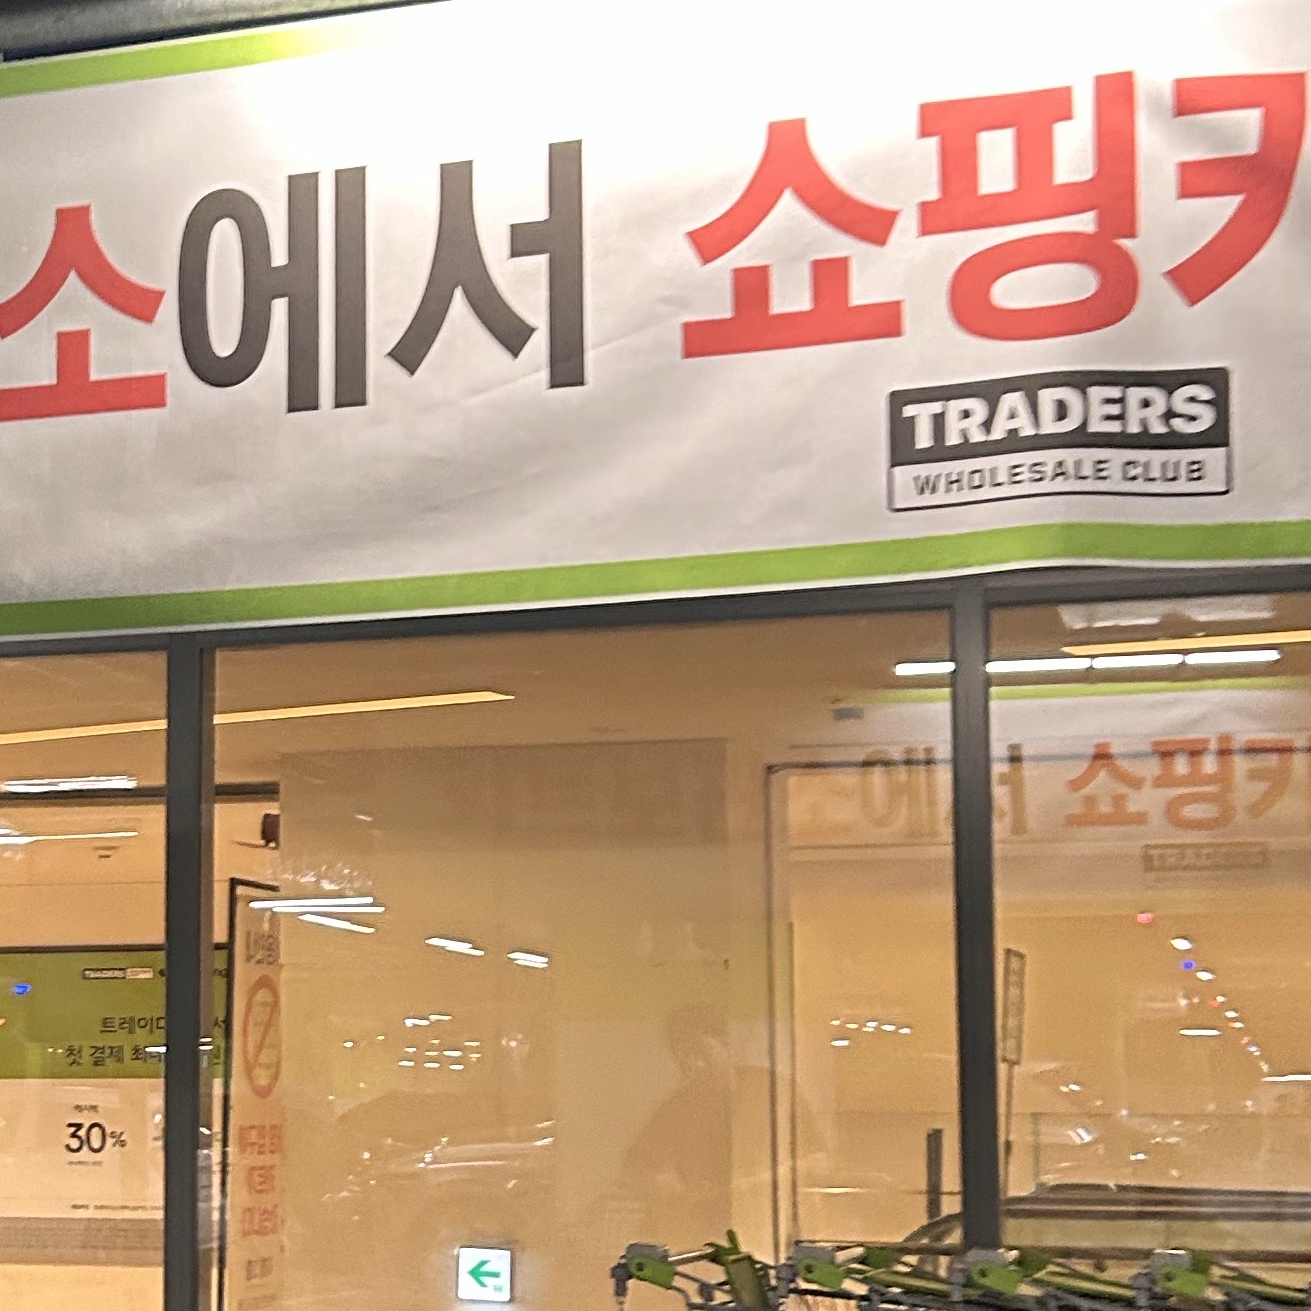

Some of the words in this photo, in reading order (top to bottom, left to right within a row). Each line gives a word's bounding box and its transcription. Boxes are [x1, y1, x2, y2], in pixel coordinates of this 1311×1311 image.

[902, 384, 1217, 450] TRADERS
[913, 459, 1110, 496] WHOLESALE
[1121, 459, 1204, 482] CLUB
[90, 1044, 124, 1066] 결제
[65, 1122, 127, 1153] 30%
